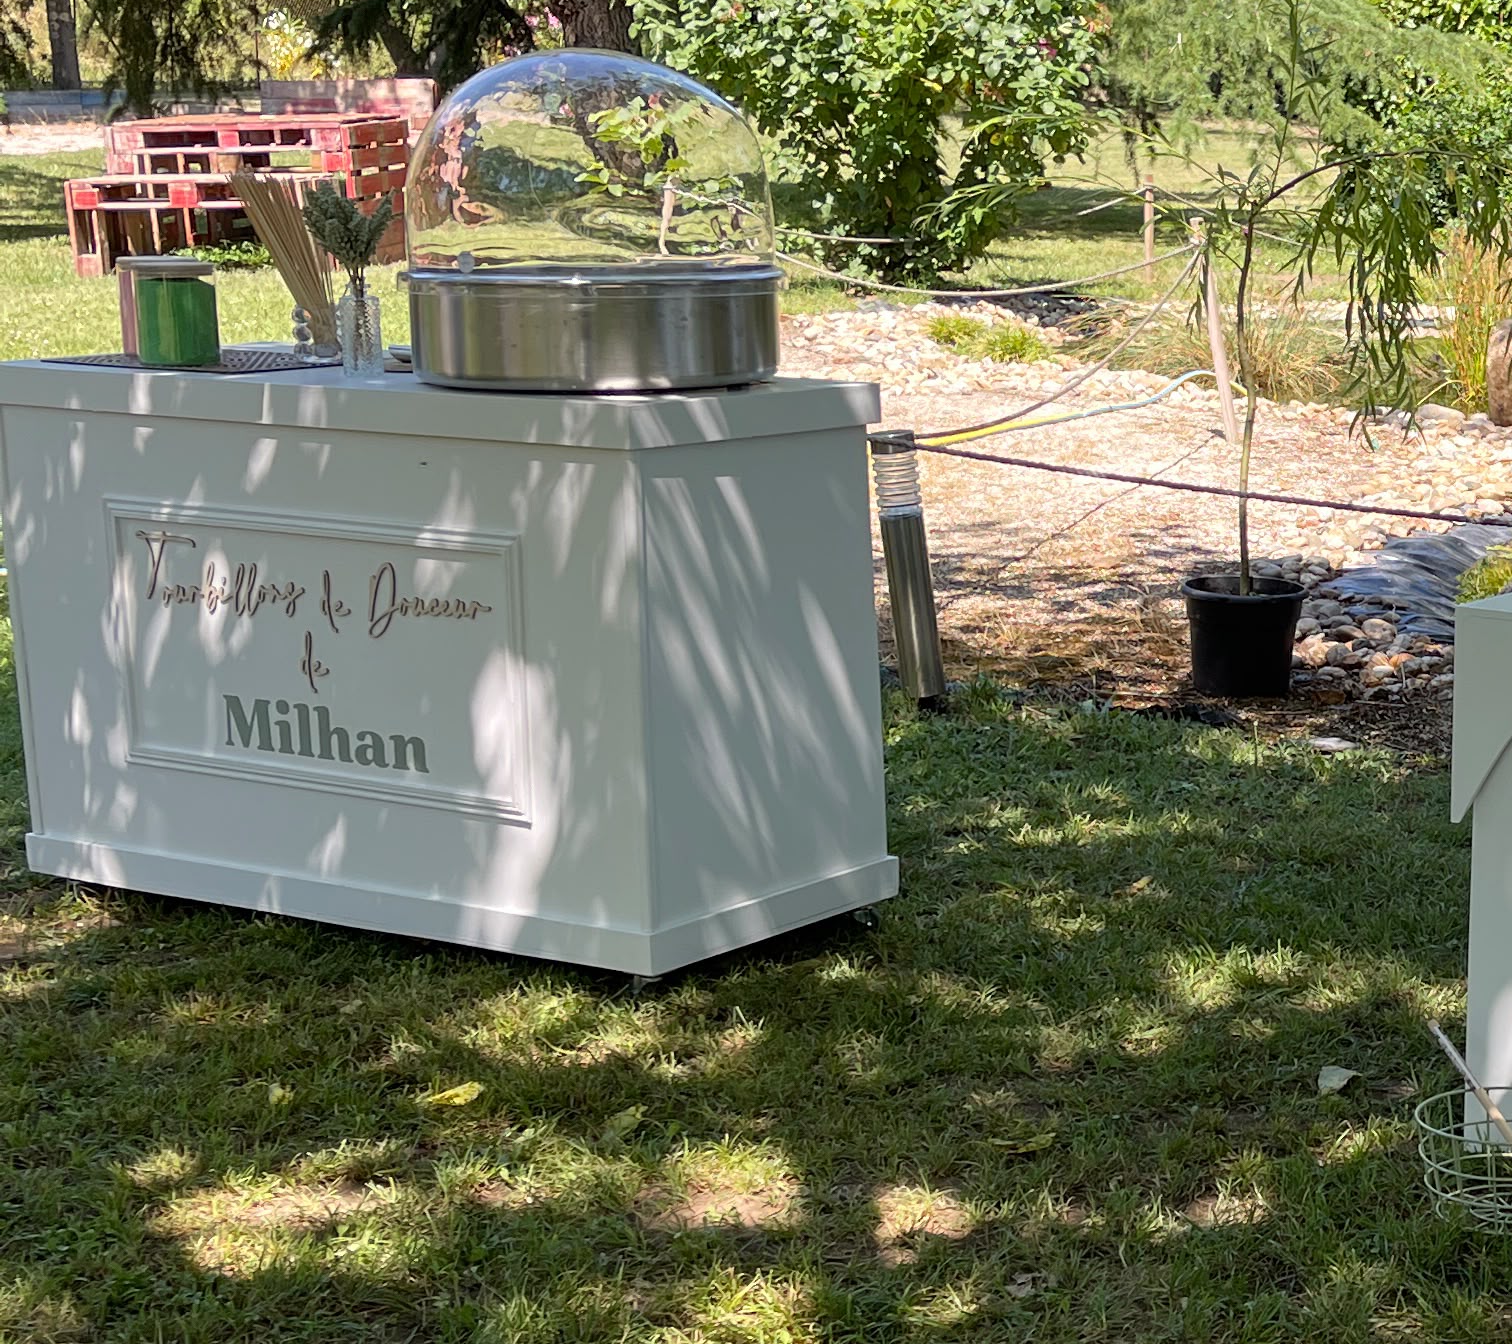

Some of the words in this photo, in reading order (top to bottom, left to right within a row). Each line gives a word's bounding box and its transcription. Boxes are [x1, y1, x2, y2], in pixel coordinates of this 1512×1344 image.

[135, 530, 306, 618] Tourbillons
[320, 569, 352, 634] de
[368, 562, 493, 639] Douceur
[301, 630, 331, 694] de
[222, 694, 430, 774] Milhan
